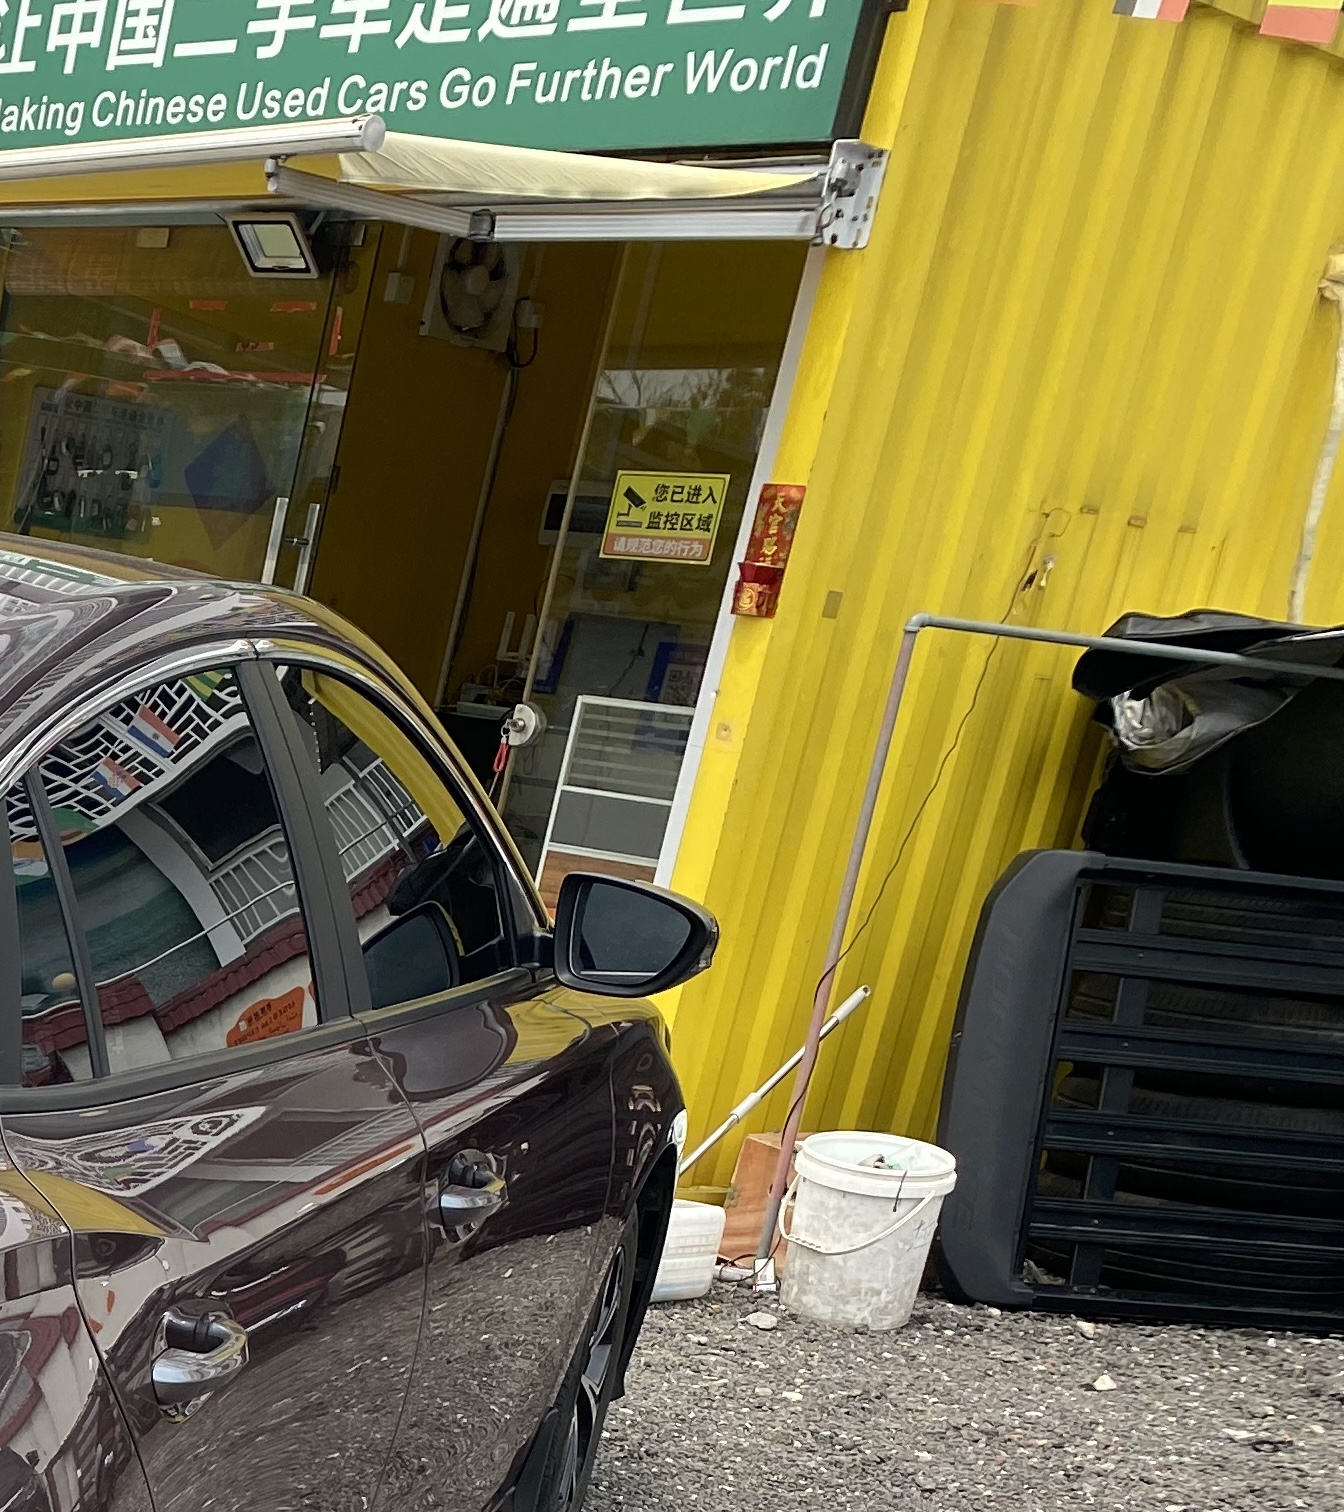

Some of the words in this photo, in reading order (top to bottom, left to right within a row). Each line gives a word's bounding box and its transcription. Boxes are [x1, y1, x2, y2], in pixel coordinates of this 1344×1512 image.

[92, 88, 228, 127] Chinese
[237, 77, 331, 120] Used
[337, 74, 429, 113] Cars
[439, 67, 496, 109] Go
[505, 57, 675, 105] Further
[686, 43, 830, 95] World
[651, 483, 718, 505] 您已进入
[645, 511, 714, 534] 监控区域
[613, 536, 704, 558] 请规范您的行为
